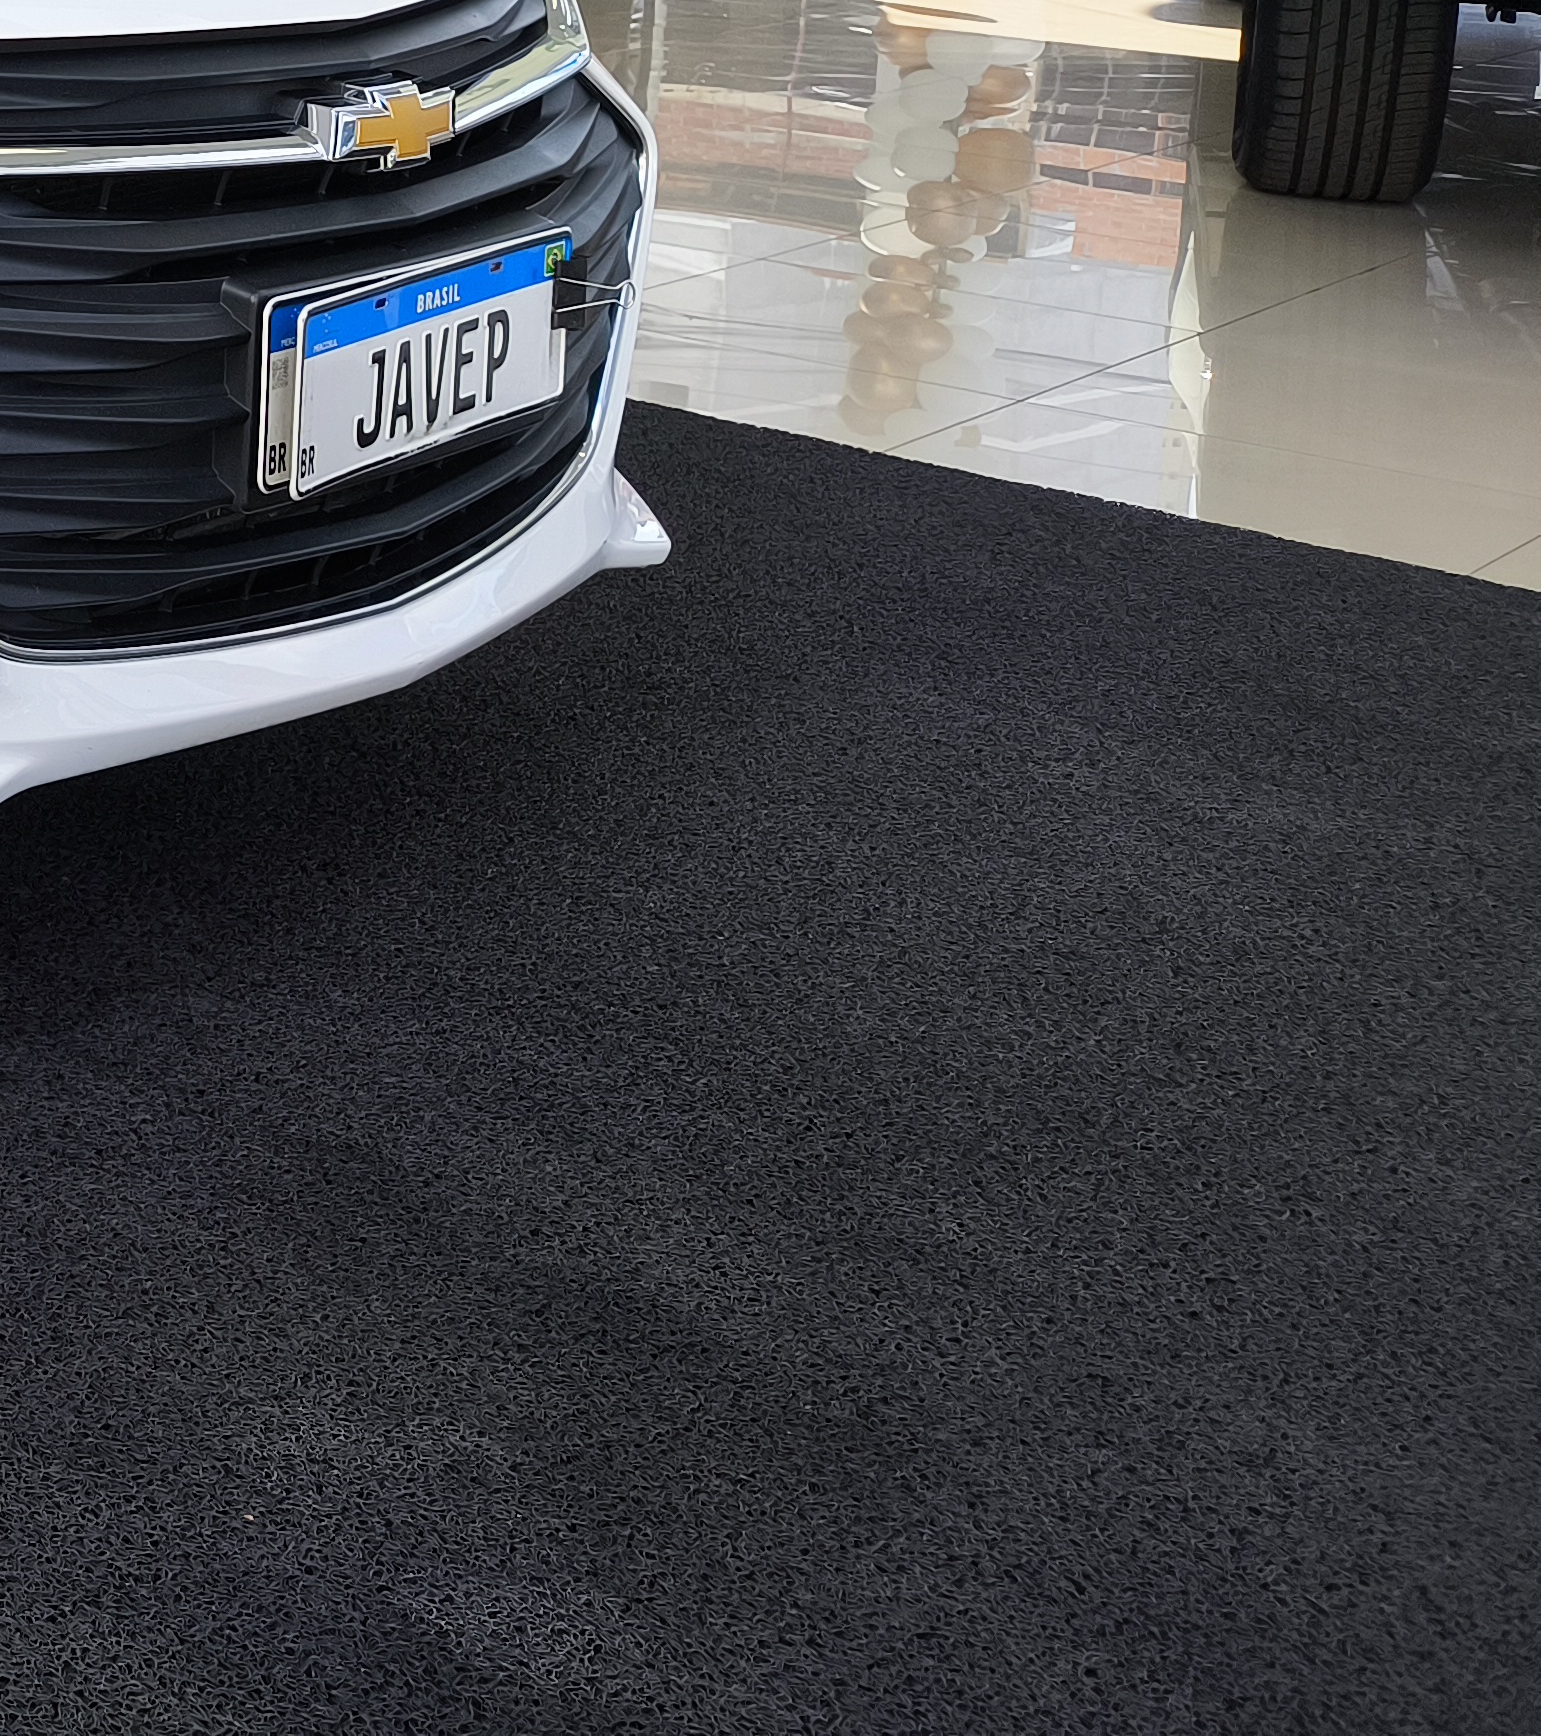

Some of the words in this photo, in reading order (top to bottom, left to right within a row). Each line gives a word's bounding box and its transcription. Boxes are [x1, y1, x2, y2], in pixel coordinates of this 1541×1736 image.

[416, 282, 461, 314] BRASIL
[355, 308, 510, 451] JAVEP
[268, 441, 287, 476] BR
[300, 445, 315, 479] BR
